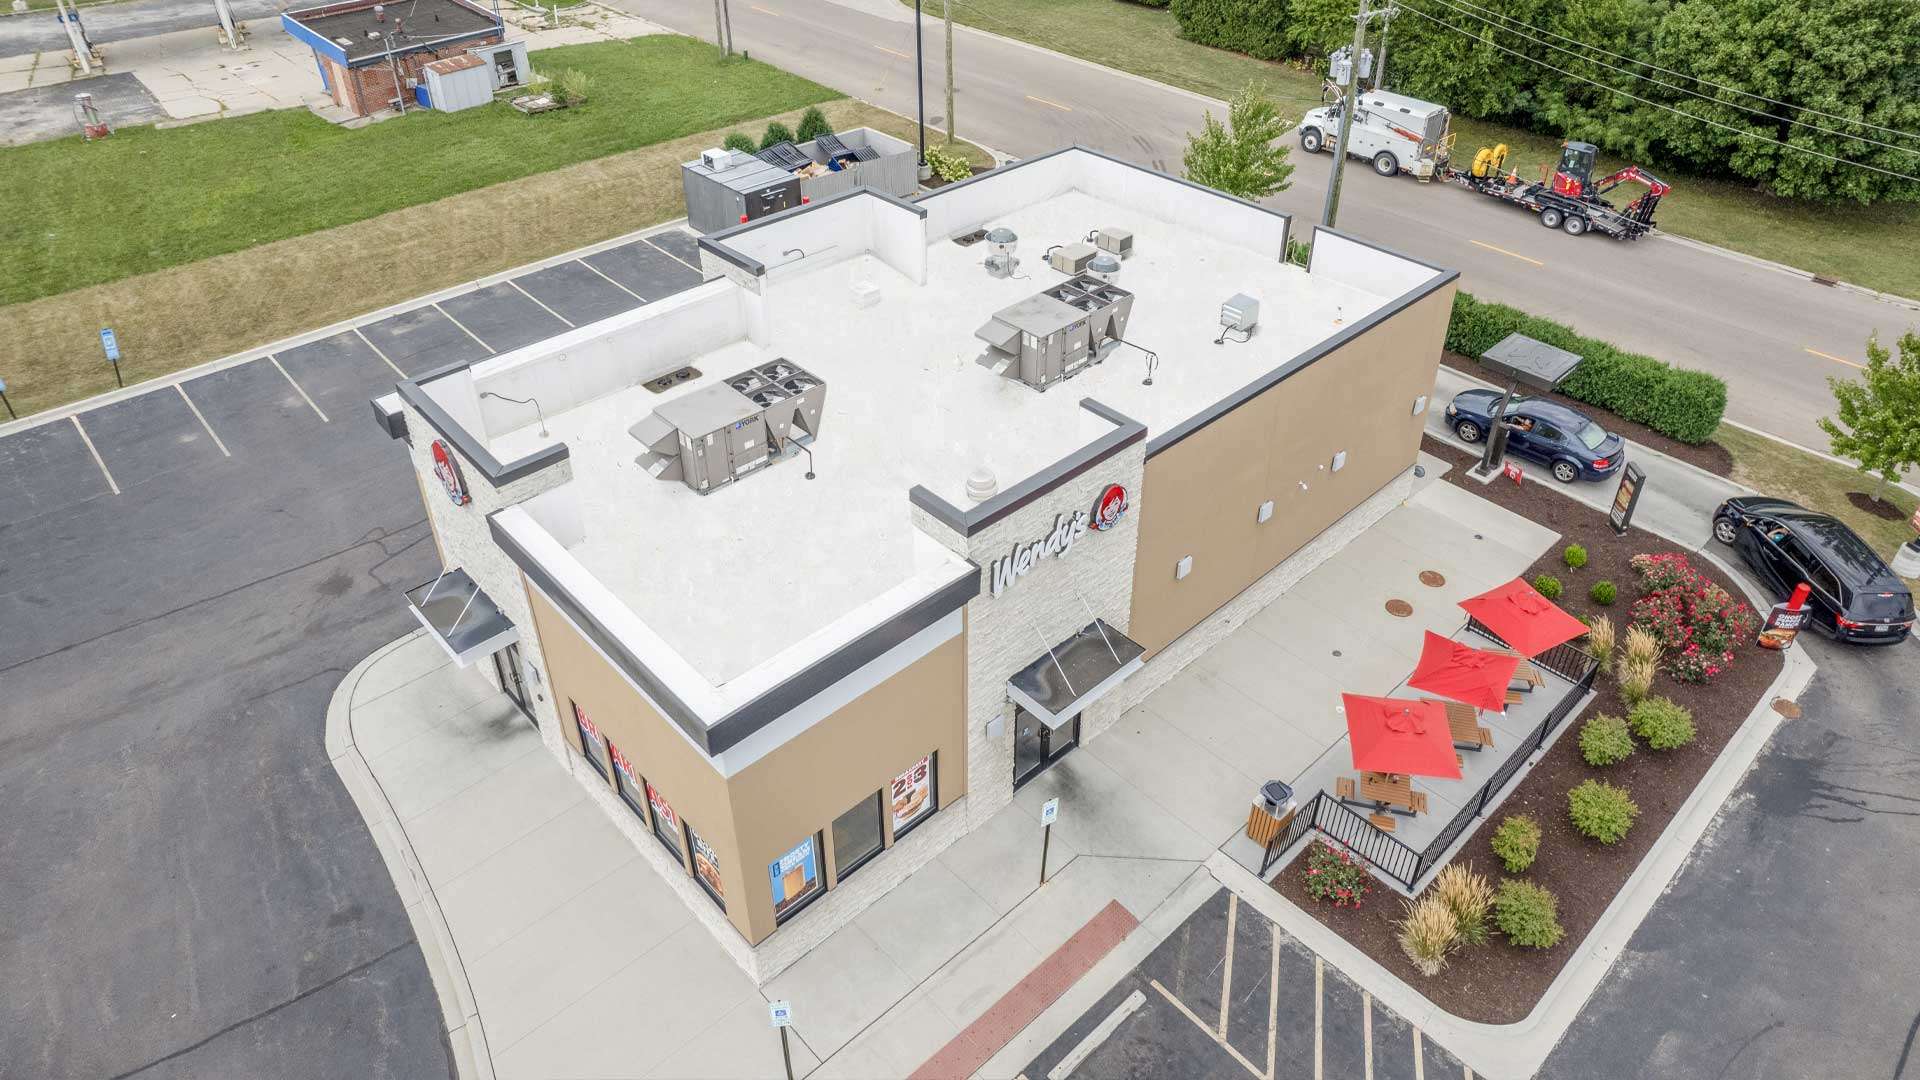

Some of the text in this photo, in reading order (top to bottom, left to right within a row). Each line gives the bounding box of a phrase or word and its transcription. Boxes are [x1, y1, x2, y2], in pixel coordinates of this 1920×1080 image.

[991, 511, 1088, 600] Wendy's
[893, 778, 906, 799] 2
[913, 764, 927, 784] 3
